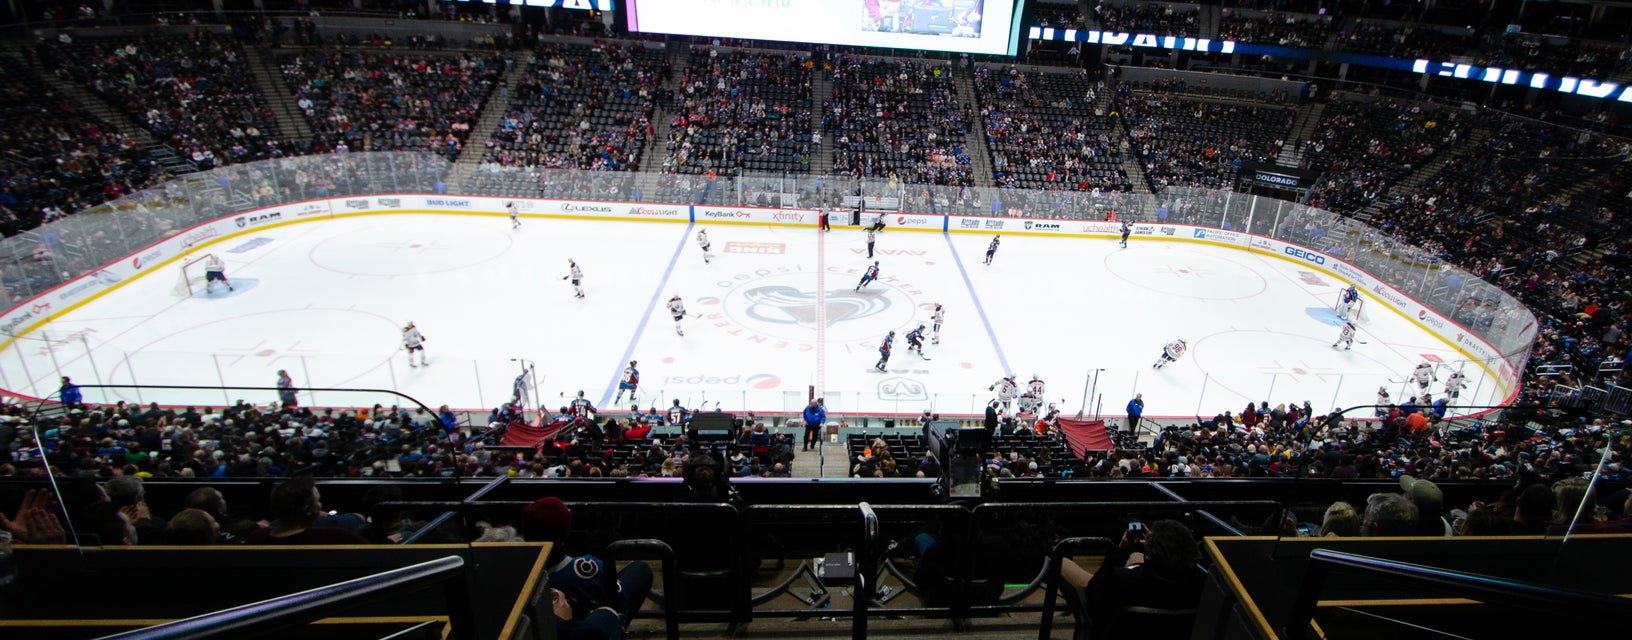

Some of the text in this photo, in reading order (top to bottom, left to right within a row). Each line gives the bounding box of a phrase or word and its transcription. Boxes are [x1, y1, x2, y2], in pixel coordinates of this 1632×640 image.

[1256, 174, 1297, 186] COLORADO
[426, 199, 445, 207] BUD
[249, 211, 281, 222] RAM
[705, 210, 735, 218] KeyBank
[772, 210, 805, 222] xfinity
[906, 217, 927, 225] pepsi
[1284, 246, 1325, 265] GEICO
[1426, 314, 1444, 329] pepsi
[663, 373, 741, 386] pepsi
[1032, 385, 1042, 395] 44
[670, 413, 681, 424] 57
